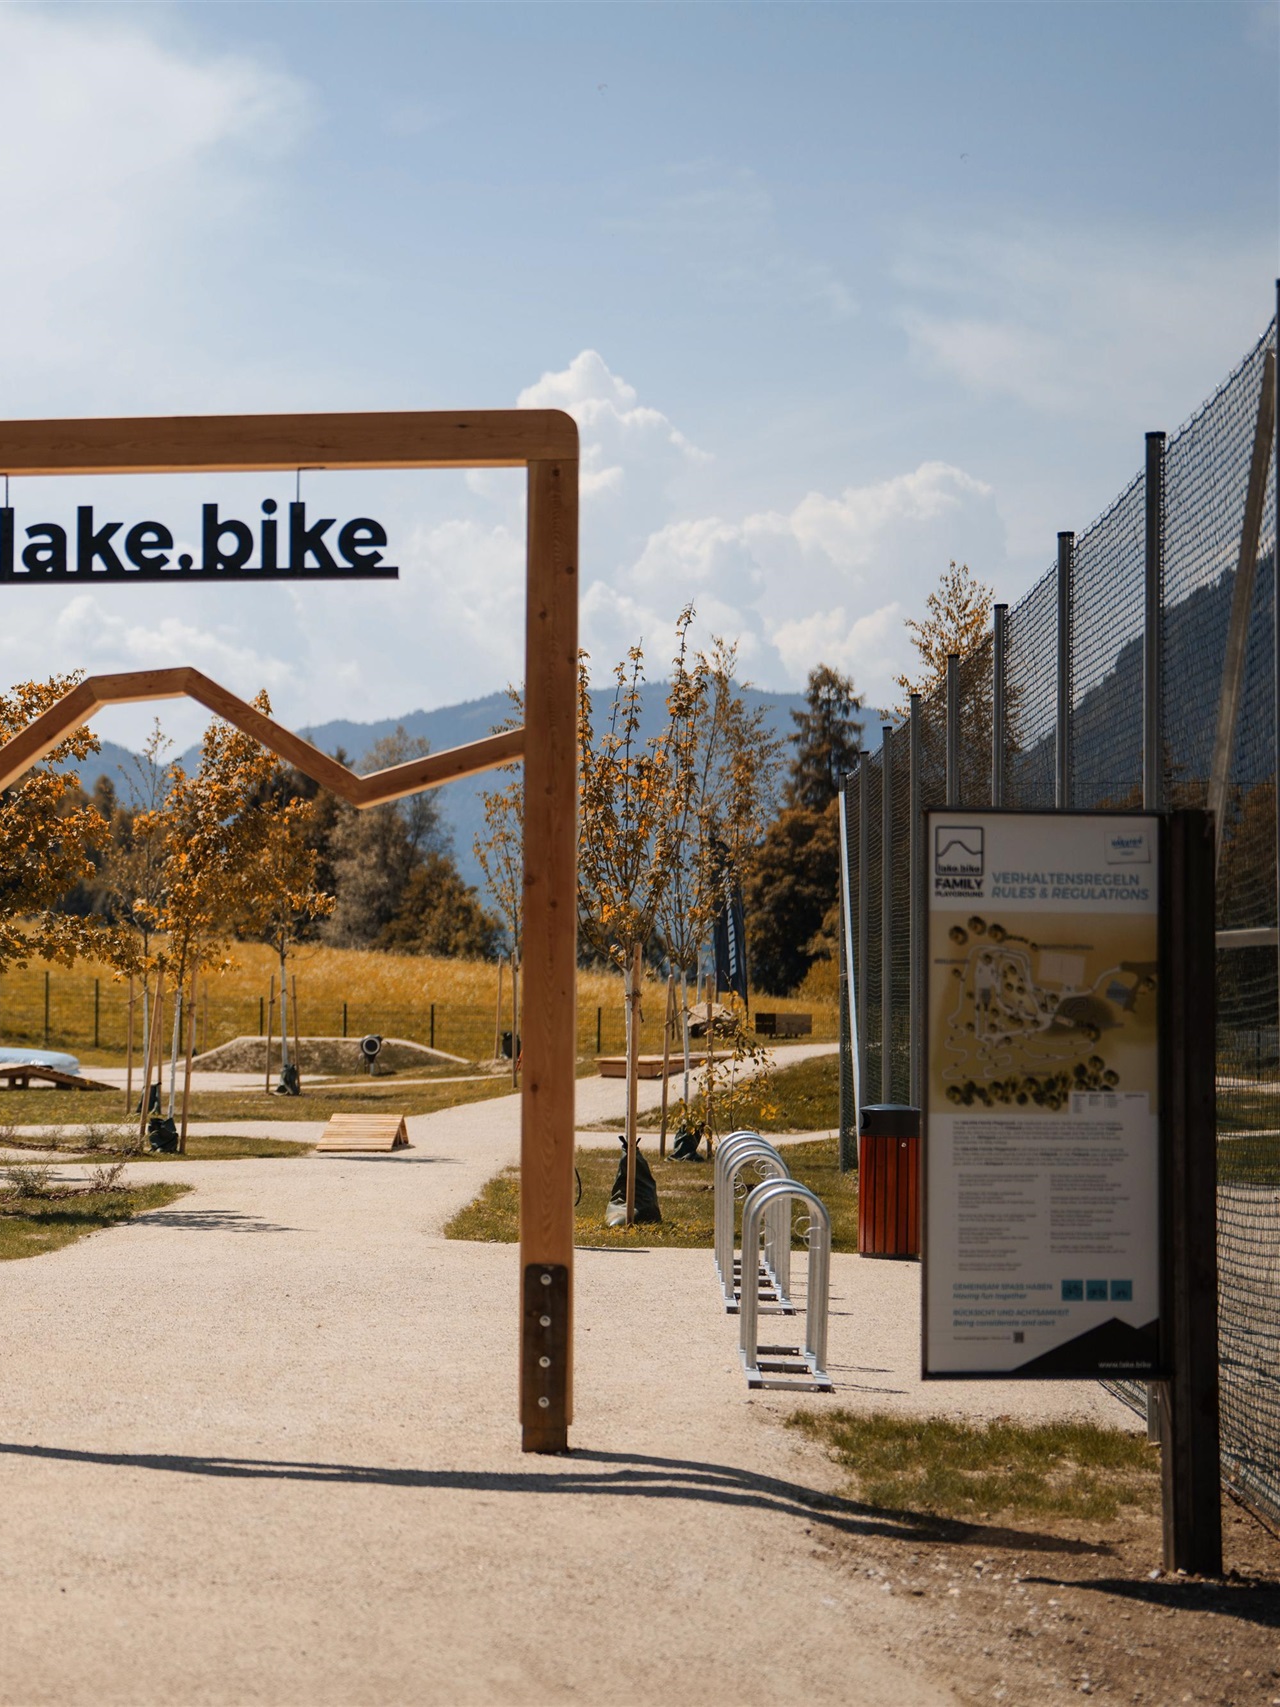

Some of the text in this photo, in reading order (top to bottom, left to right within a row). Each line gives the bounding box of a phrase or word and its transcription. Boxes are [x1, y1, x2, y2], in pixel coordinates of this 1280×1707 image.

[992, 872, 1140, 886] VERHALTENSREGELN
[935, 878, 984, 890] FAMILY
[935, 890, 984, 898] PLAYGROUND
[992, 886, 1149, 900] RULES & REGULATIONS
[1026, 1283, 1053, 1291] HABEN
[952, 1292, 1027, 1301] Having fun together
[997, 1309, 1014, 1317] UND
[952, 1319, 975, 1328] Being
[1098, 1360, 1152, 1369] www.lake.bike
